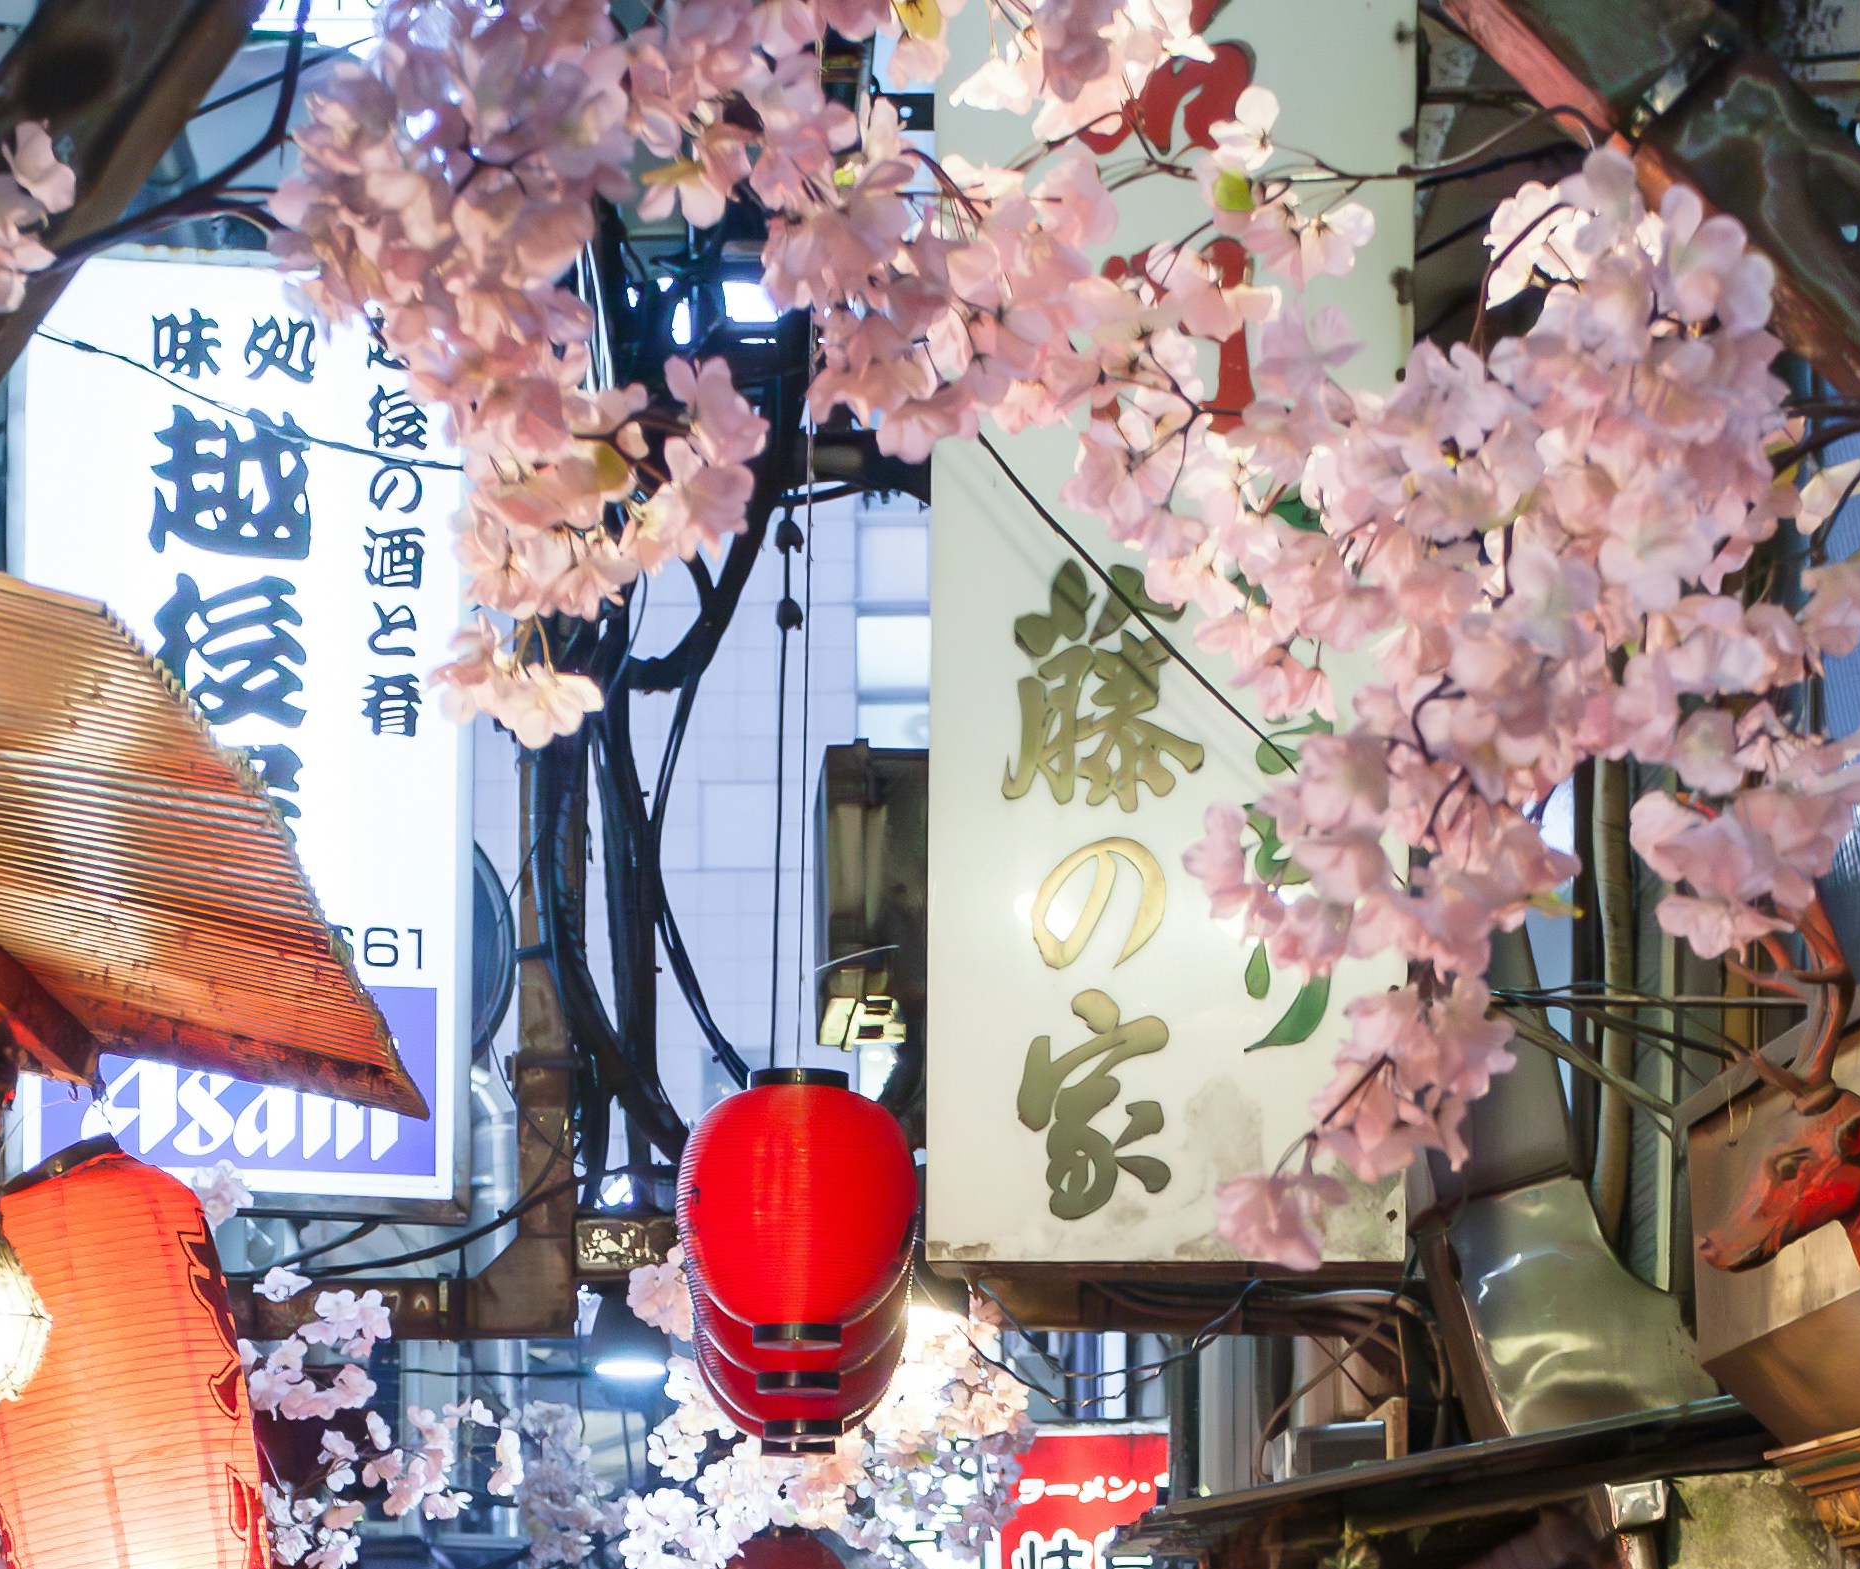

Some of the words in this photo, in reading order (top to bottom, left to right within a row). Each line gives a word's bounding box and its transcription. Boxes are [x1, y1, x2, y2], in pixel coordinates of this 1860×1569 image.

[151, 308, 317, 385] 味処
[1003, 557, 1205, 1220] 藤の家
[331, 926, 423, 970] 61
